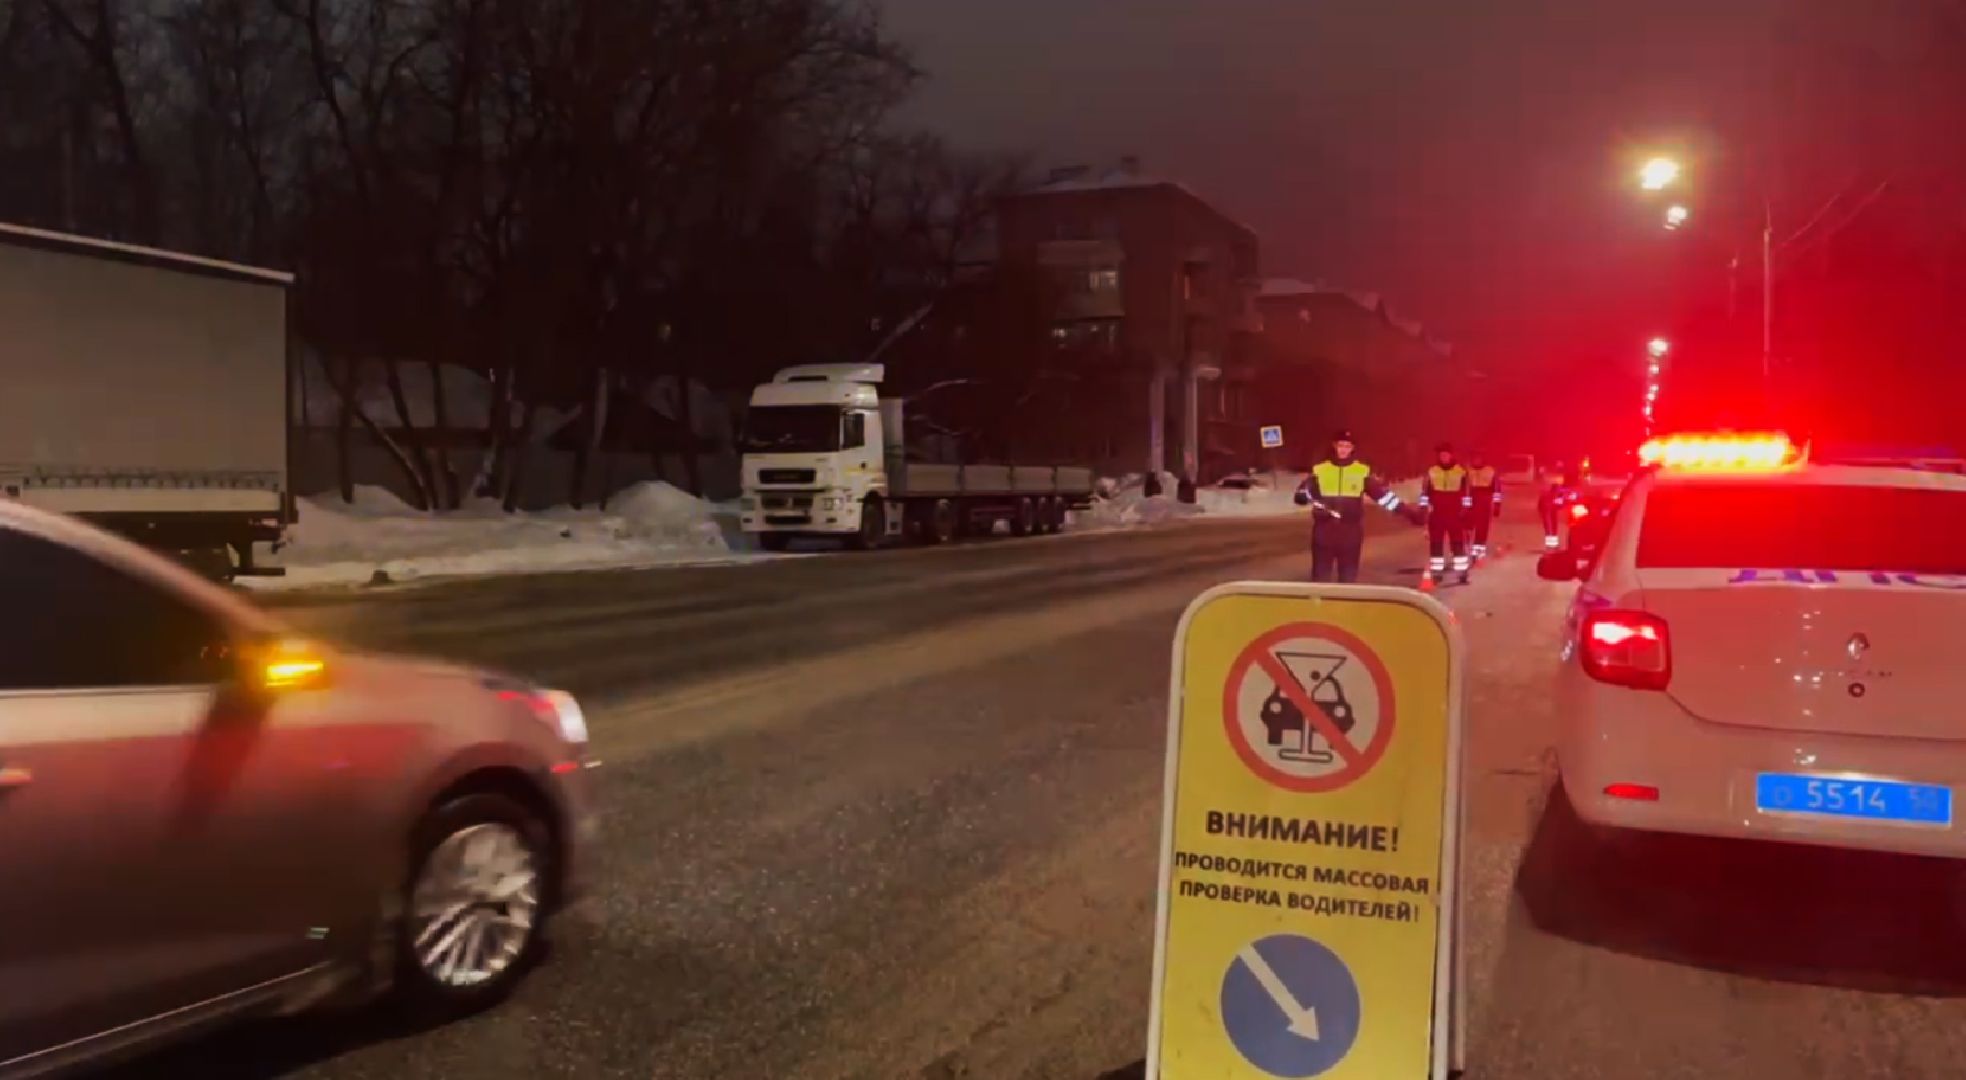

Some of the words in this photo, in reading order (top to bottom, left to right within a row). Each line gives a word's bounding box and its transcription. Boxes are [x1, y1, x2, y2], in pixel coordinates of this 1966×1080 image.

[1807, 781, 1886, 812] 5514
[1205, 810, 1399, 852] ВНИМАНИЕ!
[1175, 851, 1307, 881] ПРОВОДИТСЯ
[1313, 866, 1429, 894] МАССОВАЯ
[1179, 880, 1281, 907] ПРОВЕРКА
[1287, 893, 1419, 922] ВОДИТЕЛЕЙ!
